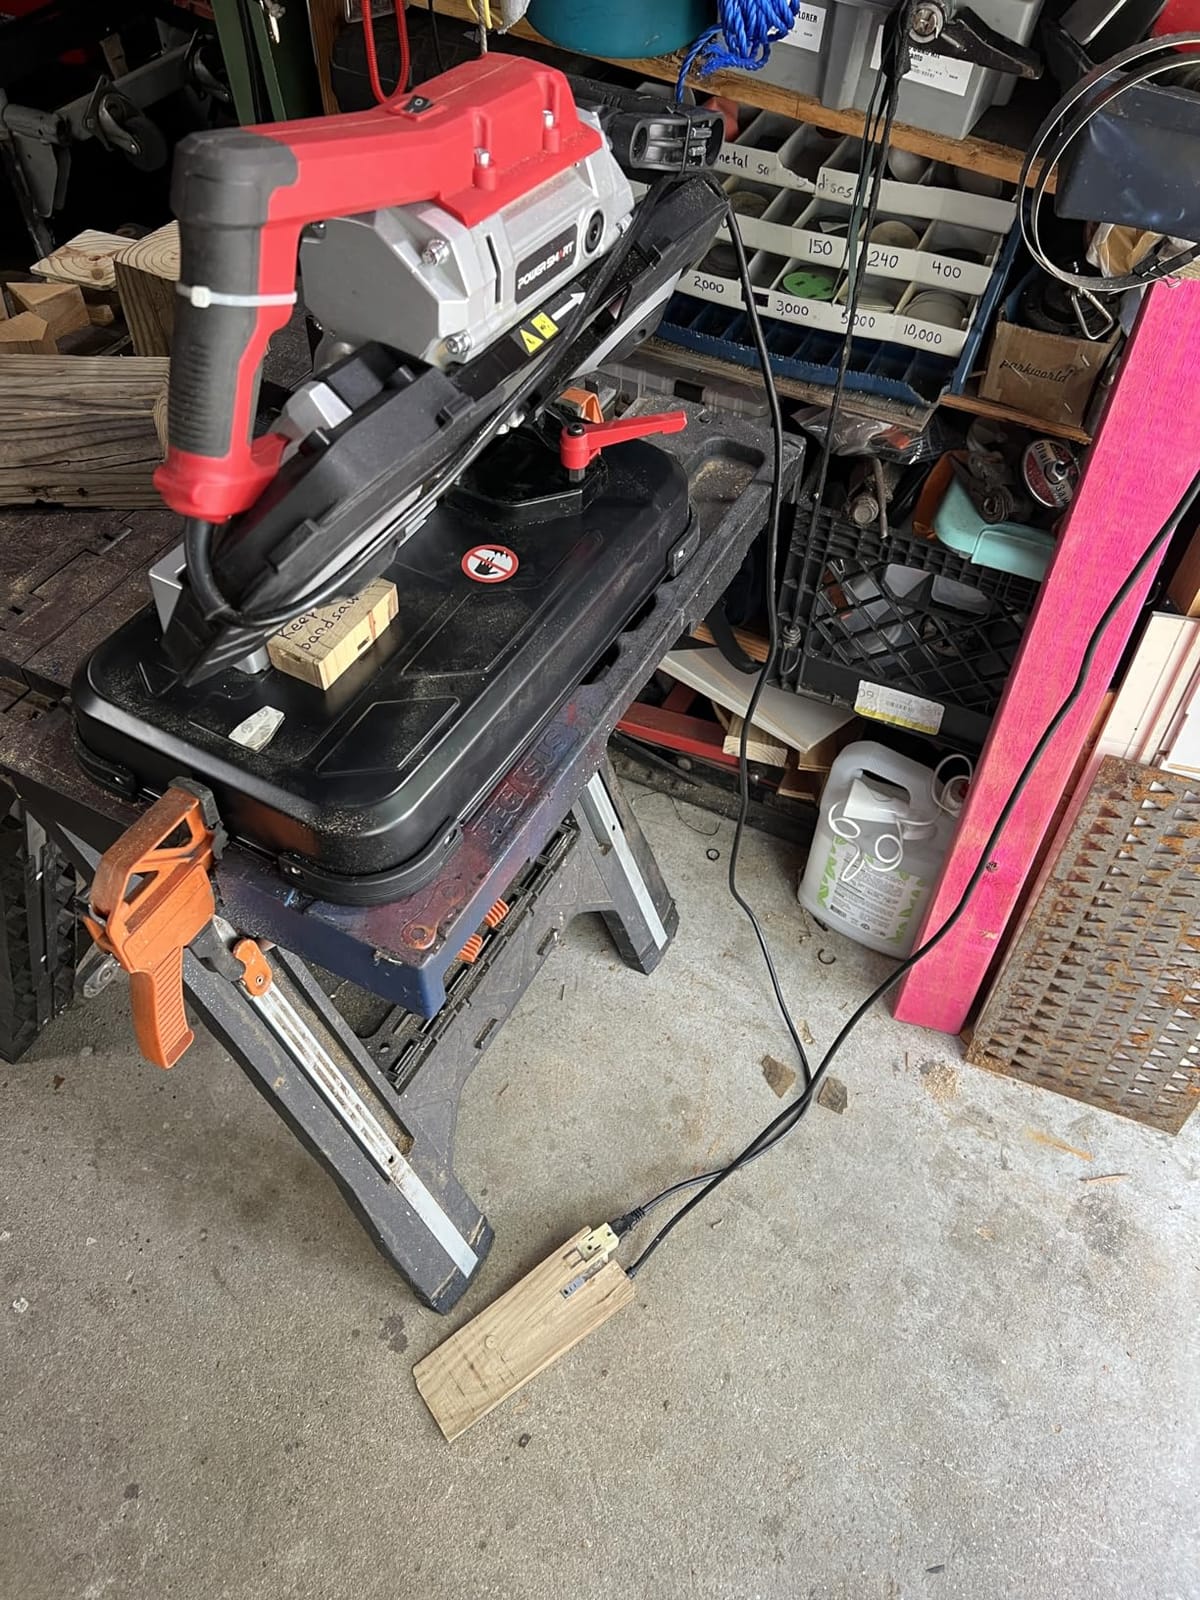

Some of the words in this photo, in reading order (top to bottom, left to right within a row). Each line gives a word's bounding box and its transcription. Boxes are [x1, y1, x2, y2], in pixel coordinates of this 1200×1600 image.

[808, 239, 833, 256] 150
[867, 250, 899, 270] 240
[932, 260, 962, 279] 400
[693, 275, 725, 294] 2,000
[776, 300, 809, 317] 3,000
[903, 323, 942, 345] 10,000
